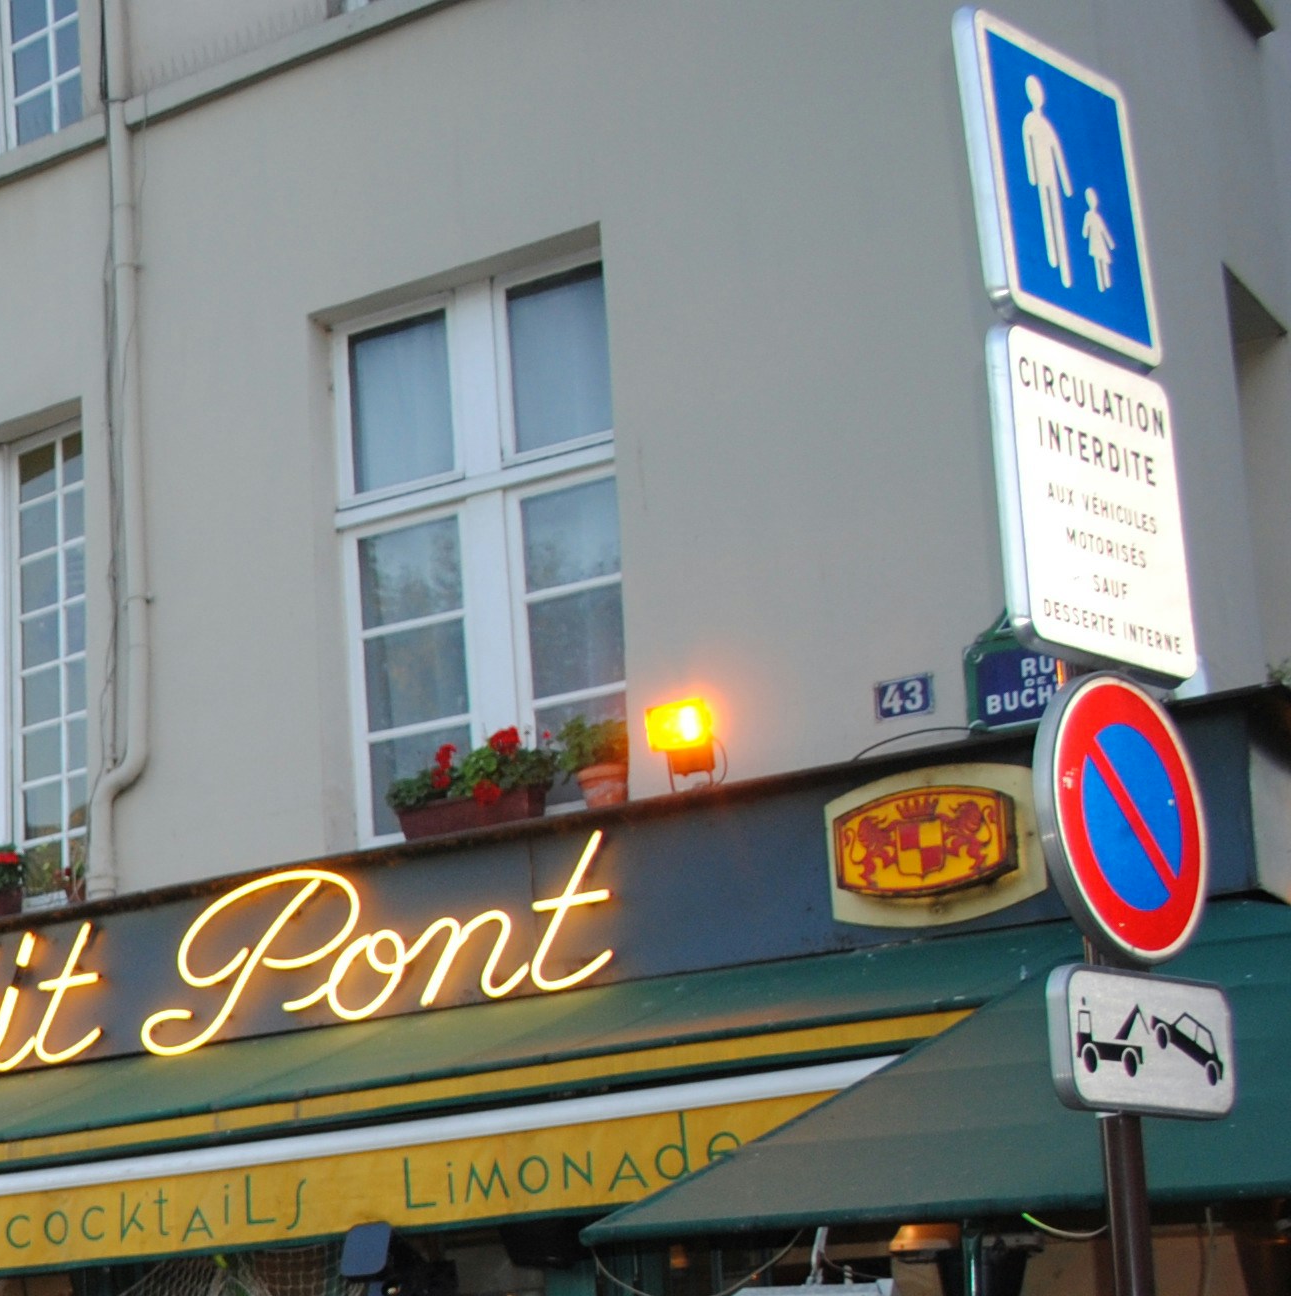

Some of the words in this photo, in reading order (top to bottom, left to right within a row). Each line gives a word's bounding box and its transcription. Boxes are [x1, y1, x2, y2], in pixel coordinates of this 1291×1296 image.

[1019, 356, 1165, 440] CIRCULATION
[1038, 416, 1157, 487] INTERDITE
[1048, 482, 1074, 507] AUX
[1082, 492, 1158, 536] VÉHICULES
[1066, 527, 1148, 569] MOTORISÉS
[1093, 574, 1128, 600] SAUF
[1043, 598, 1116, 637] DESSERTE
[1122, 621, 1182, 655] INTERNE
[1021, 655, 1055, 678] RU
[1025, 677, 1047, 687] DE
[882, 679, 924, 714] 43
[986, 685, 1057, 715] BUCH
[139, 828, 616, 1059] Pont
